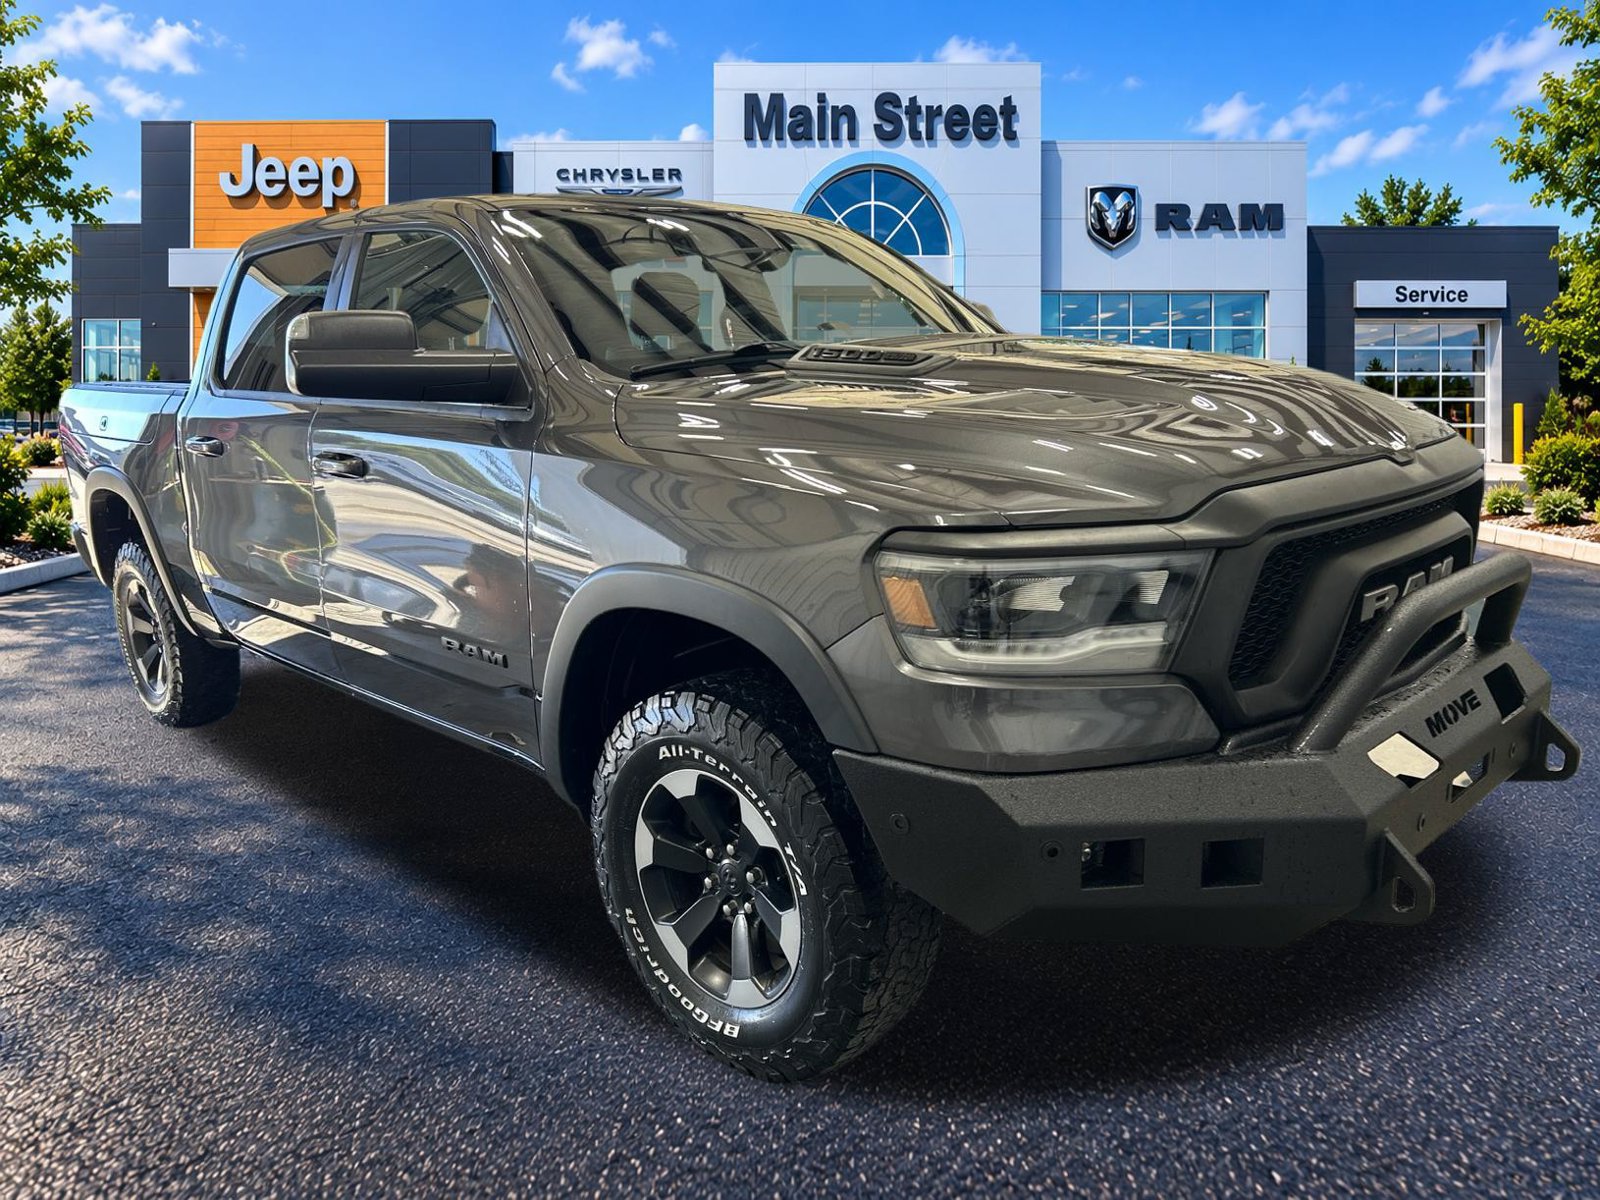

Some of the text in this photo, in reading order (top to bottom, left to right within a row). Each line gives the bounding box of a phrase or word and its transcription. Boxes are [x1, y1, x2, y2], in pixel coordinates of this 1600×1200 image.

[744, 92, 1017, 141] Main Street
[219, 143, 354, 207] Jeep
[556, 168, 682, 182] CHRYSLER
[1155, 203, 1283, 230] RAM
[1395, 285, 1468, 303] Service
[811, 347, 881, 361] 1500
[441, 636, 508, 668] RAM
[1425, 688, 1481, 738] MOVE
[658, 744, 808, 895] All-Terrain T/A
[625, 908, 740, 1038] BFGoodrich
